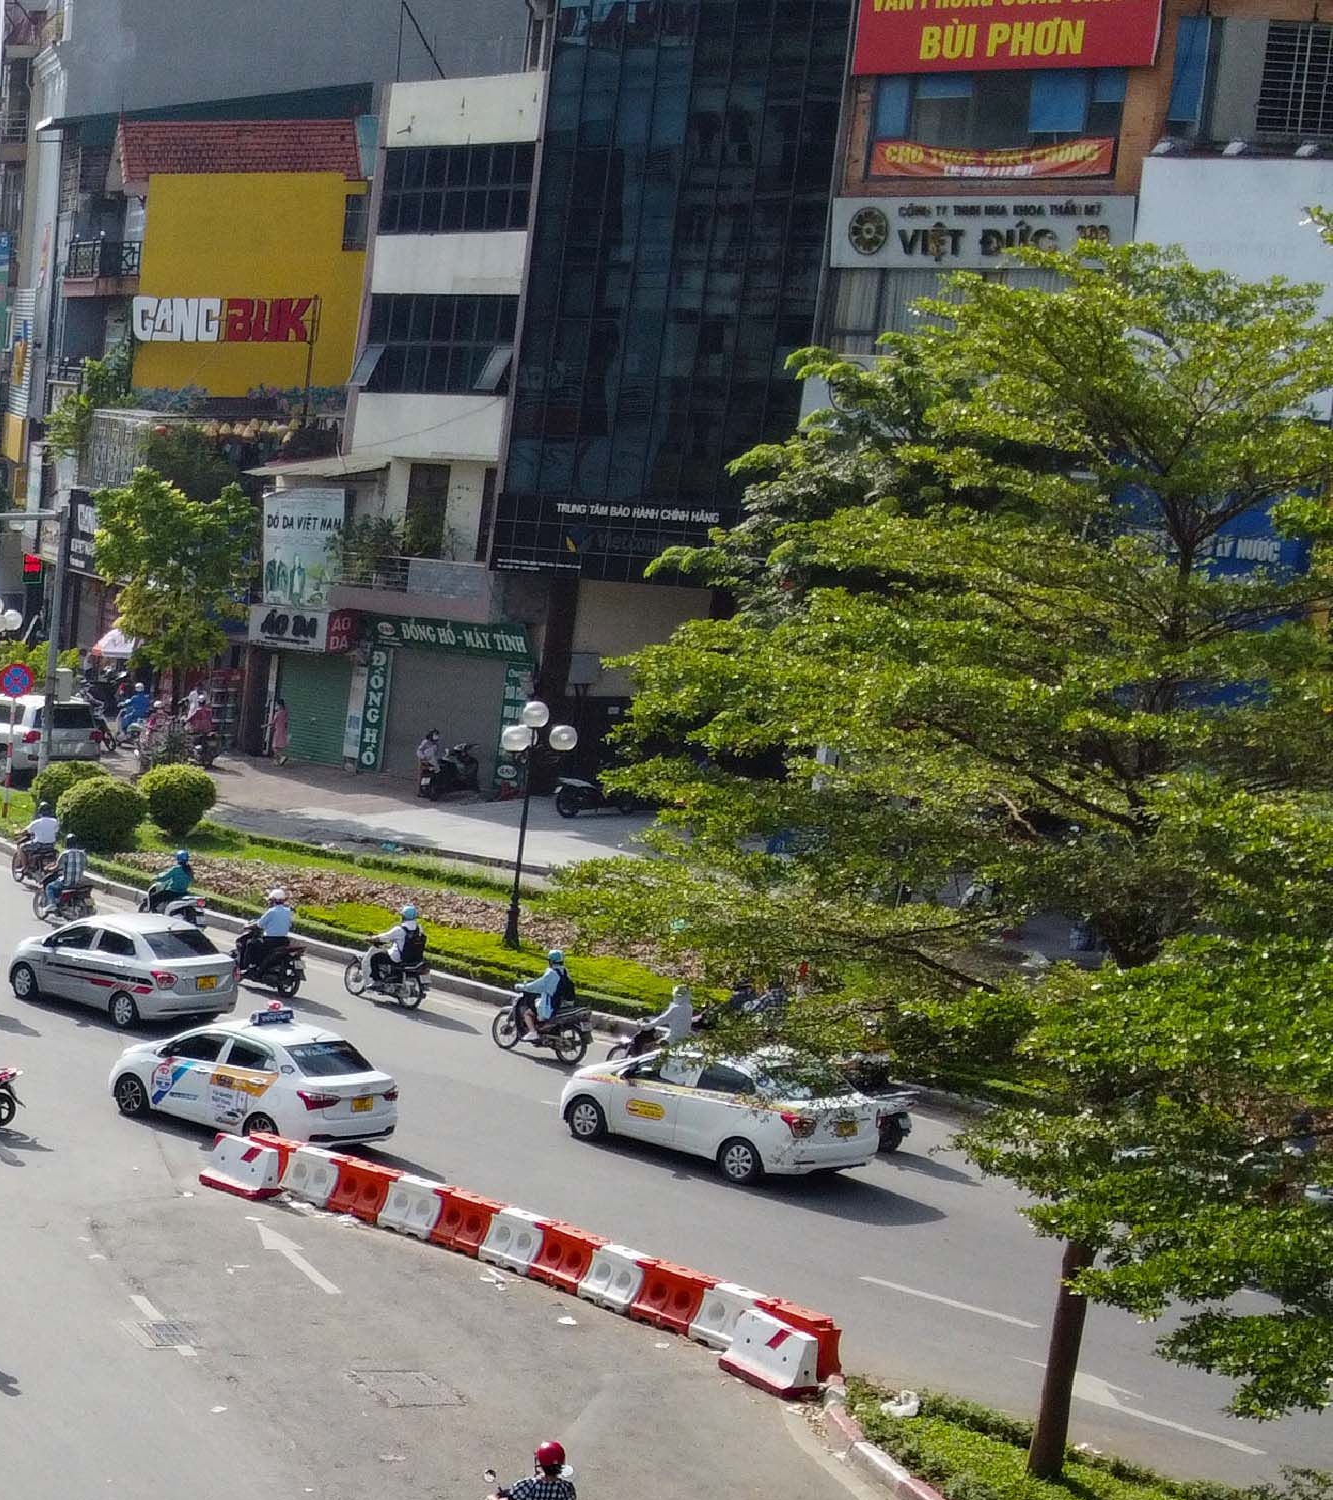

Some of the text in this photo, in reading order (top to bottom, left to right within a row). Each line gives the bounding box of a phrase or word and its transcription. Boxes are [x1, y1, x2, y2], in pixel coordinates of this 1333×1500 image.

[920, 17, 1085, 59] BÙI PHƠN
[898, 221, 966, 261] VIỆT
[283, 515, 293, 529] DA
[297, 513, 318, 530] VIỆT
[401, 618, 436, 643] ĐỒNG
[437, 621, 455, 646] HỒ
[463, 627, 492, 649] MÁY
[493, 630, 527, 654] TÍNH
